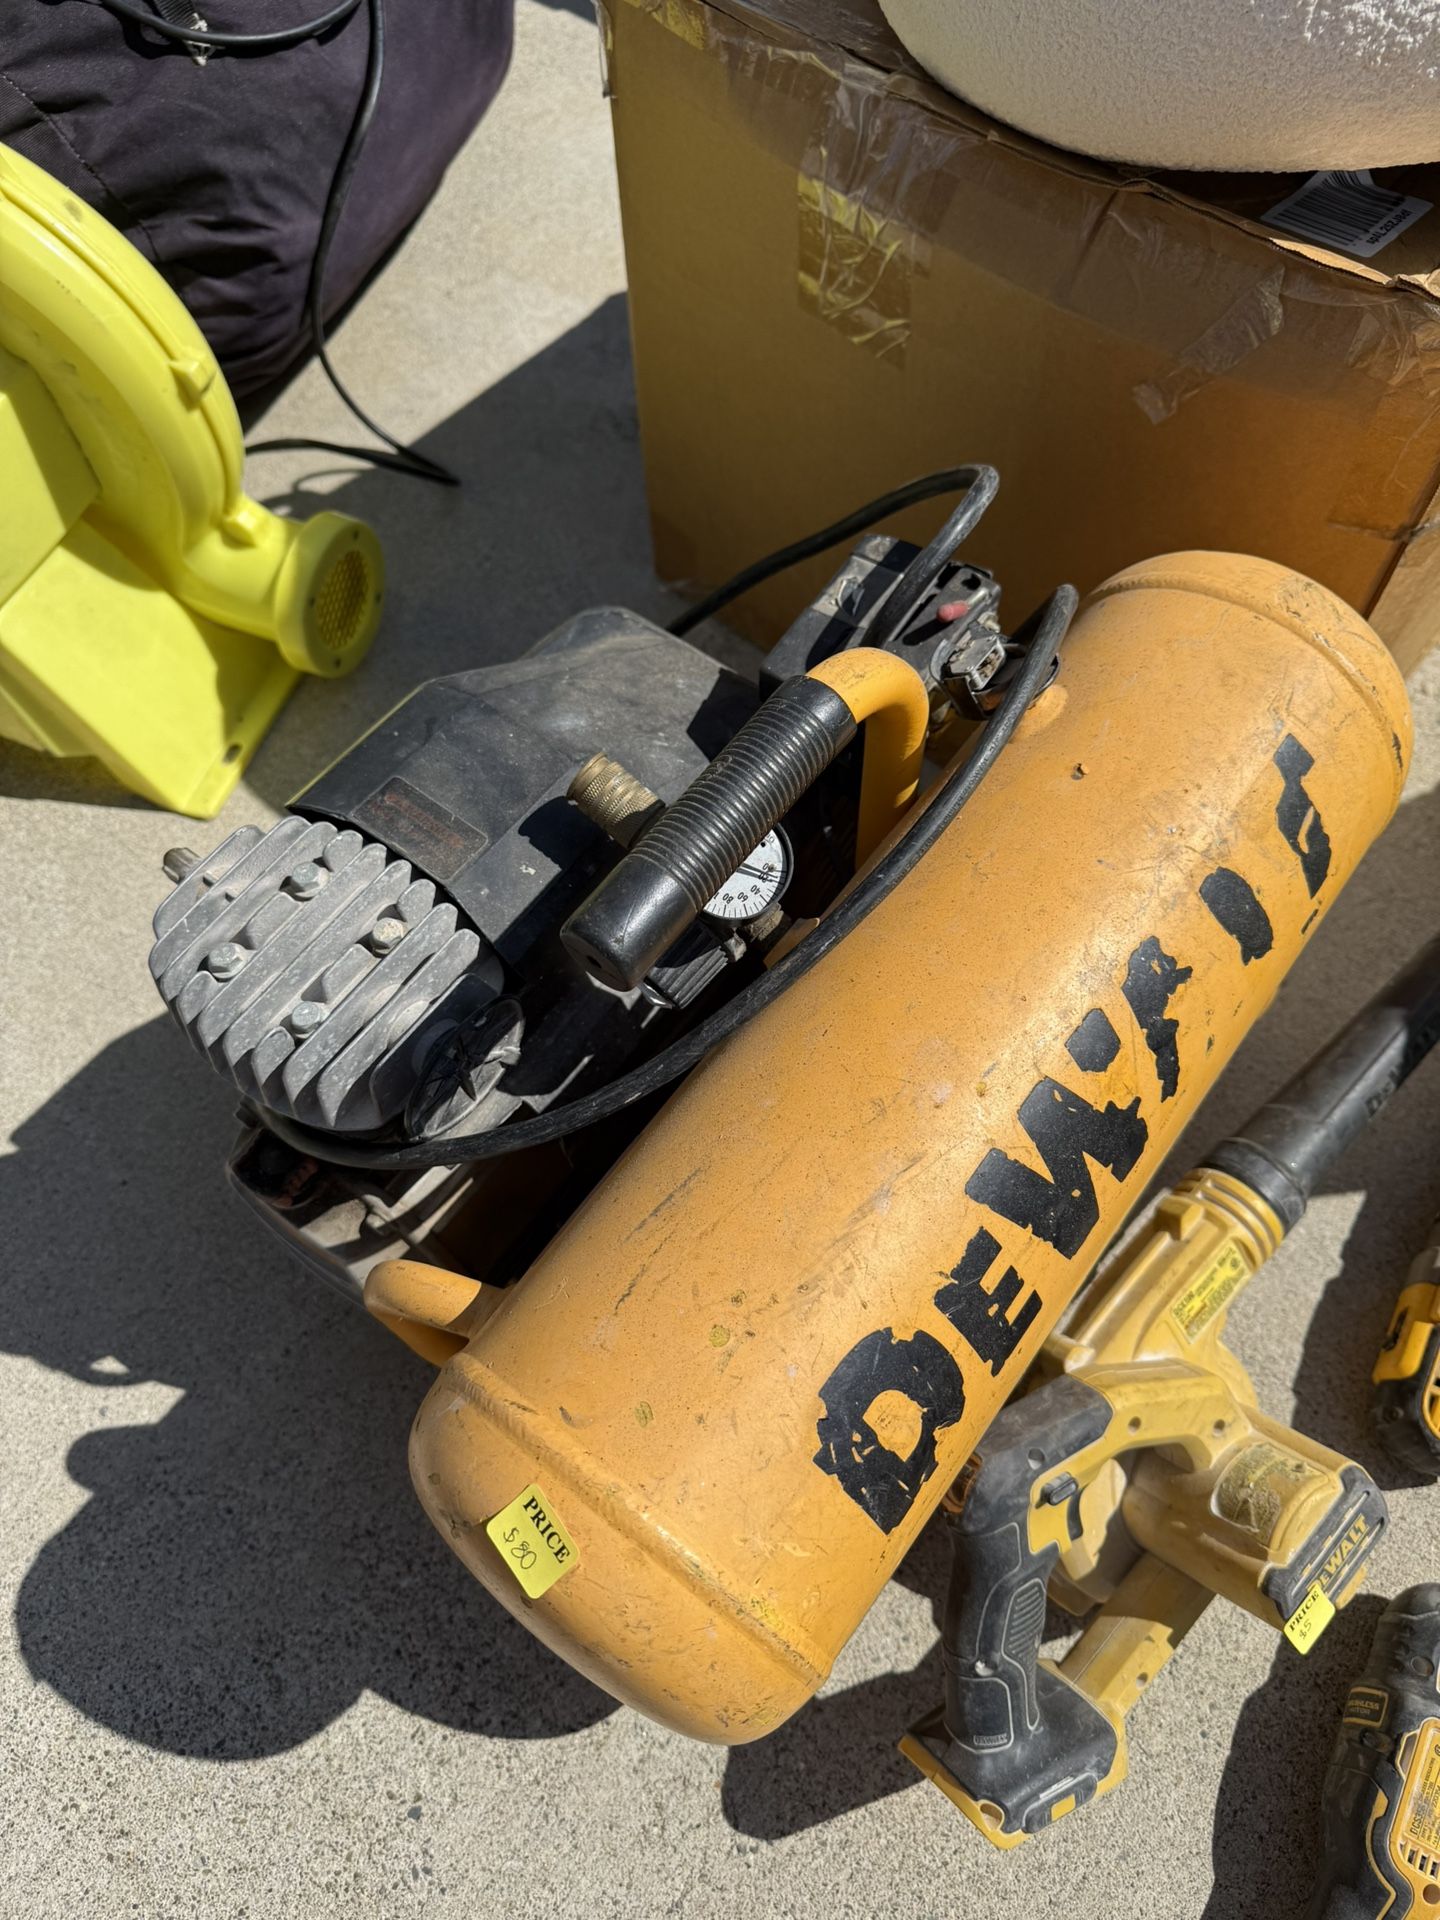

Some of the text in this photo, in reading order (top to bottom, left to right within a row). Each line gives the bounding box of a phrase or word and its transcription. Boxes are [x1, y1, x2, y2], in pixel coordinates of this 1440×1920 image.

[722, 892, 734, 904] 80
[737, 892, 748, 902] 60
[750, 884, 761, 895] 40
[522, 1495, 571, 1564] PRICE
[1306, 1512, 1367, 1592] DEWALT
[1289, 1590, 1319, 1632] PRICE
[1299, 1619, 1312, 1640] $5
[1410, 1804, 1427, 1836] DCS35
